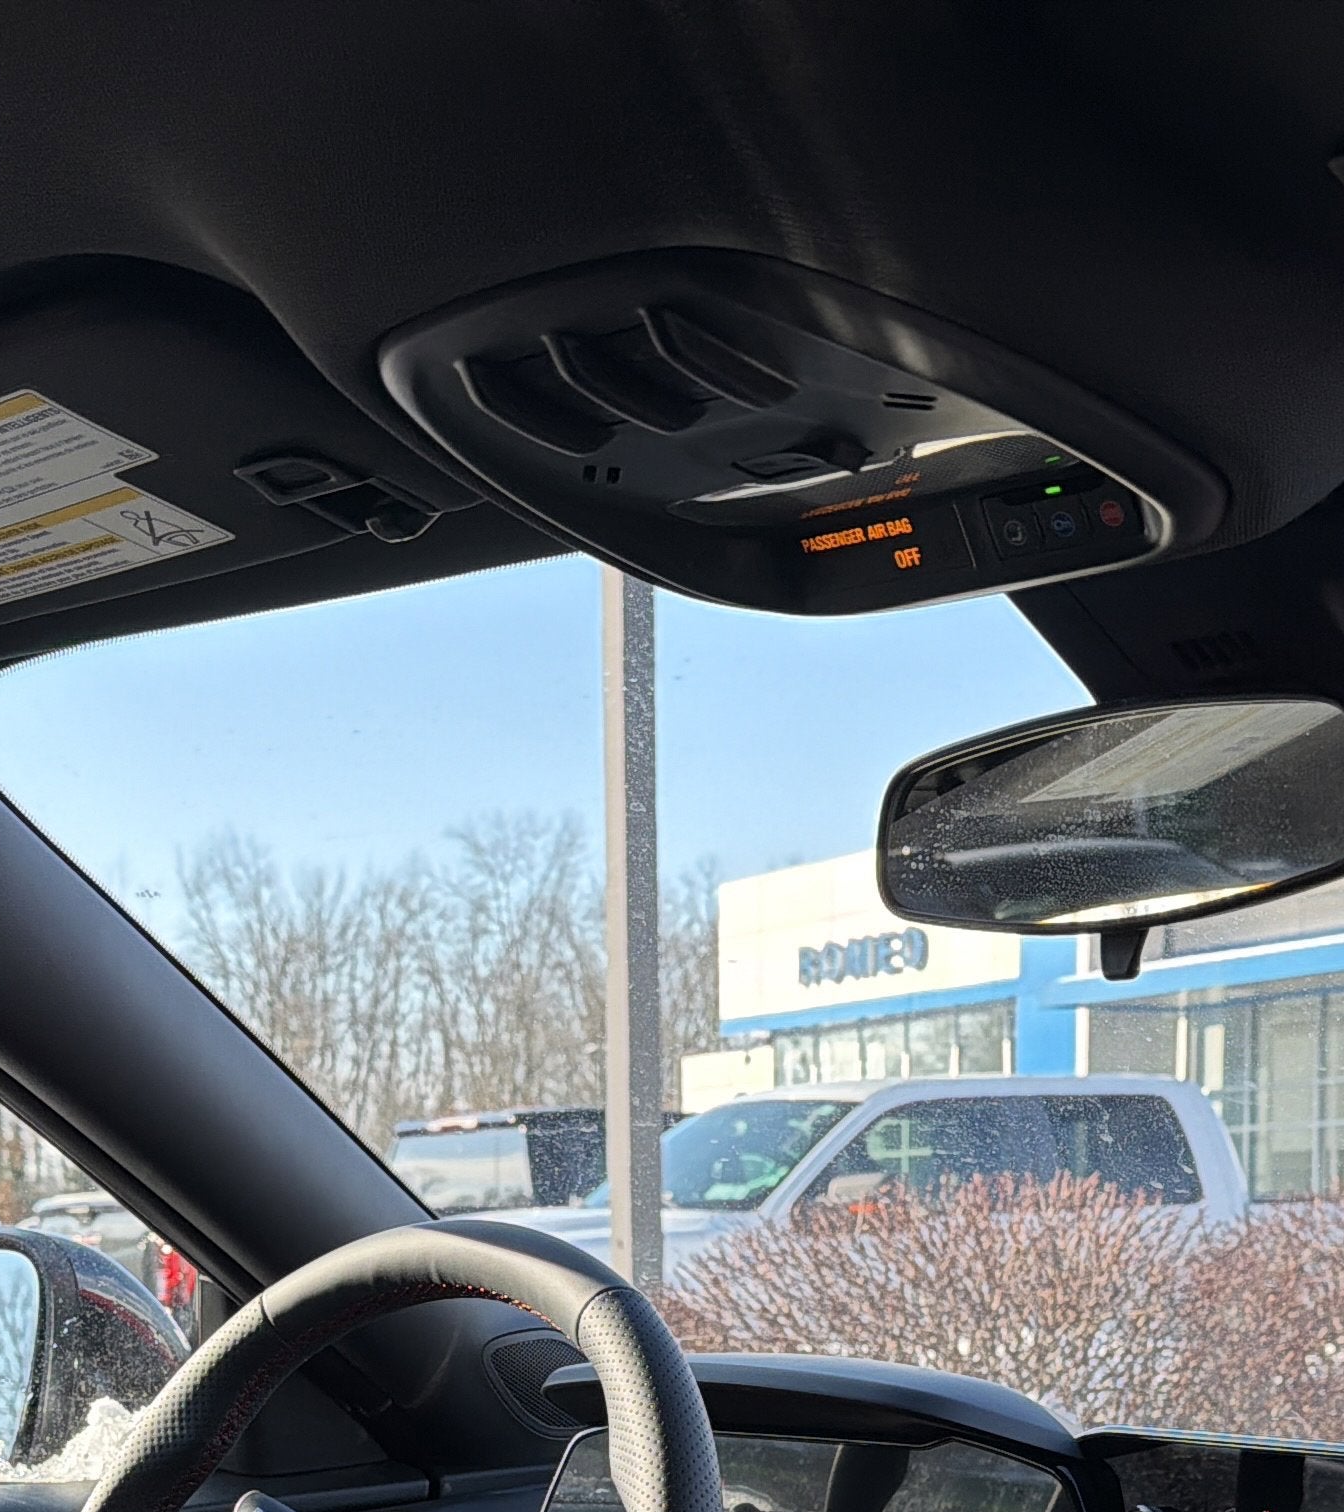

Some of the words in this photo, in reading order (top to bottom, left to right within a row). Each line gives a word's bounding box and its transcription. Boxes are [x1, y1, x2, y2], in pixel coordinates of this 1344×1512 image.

[800, 527, 866, 553] PASSENGER
[867, 523, 888, 541] AIR
[886, 517, 913, 537] BAG
[894, 547, 922, 569] OFF
